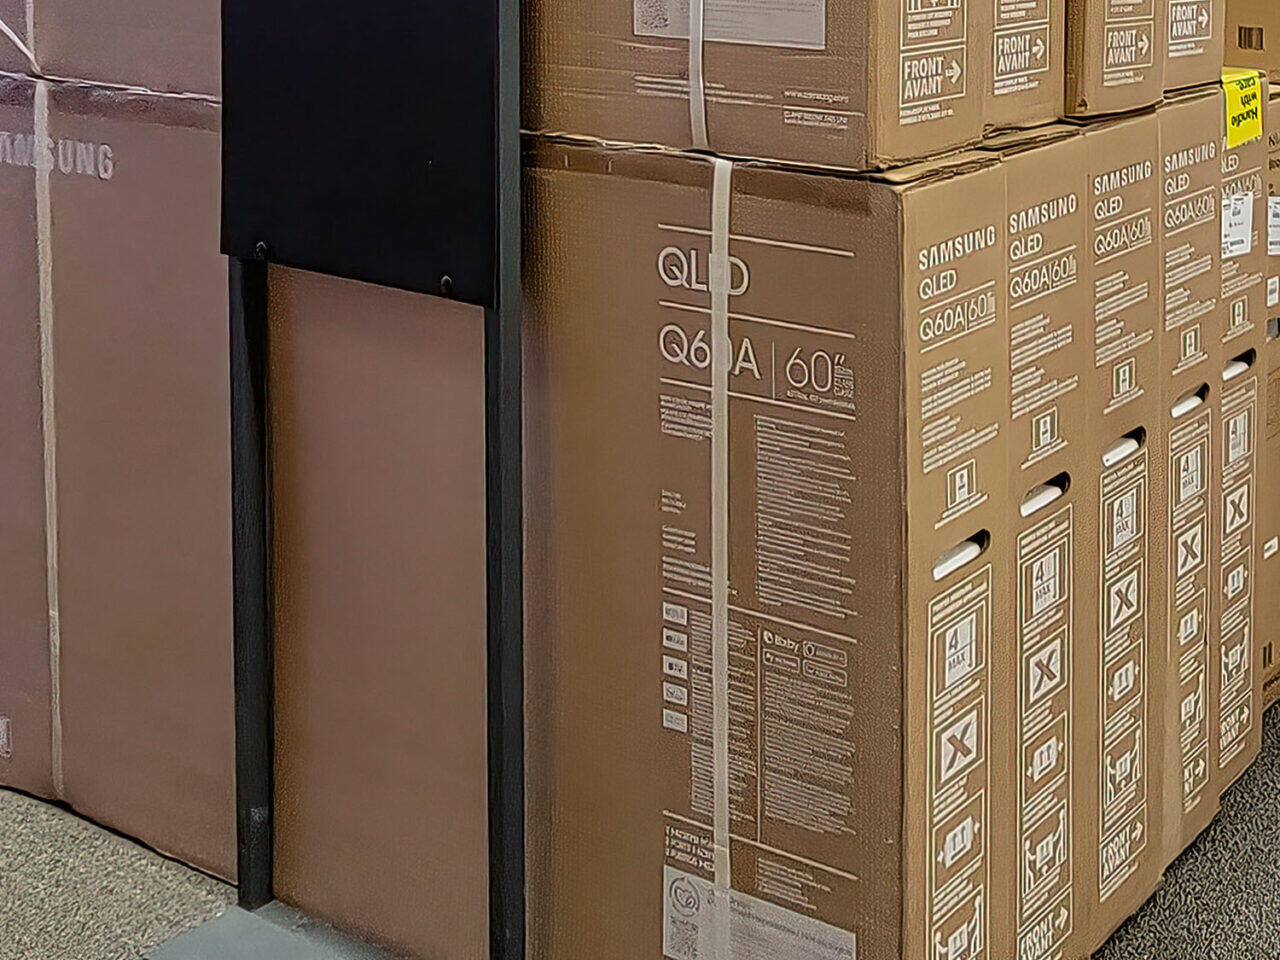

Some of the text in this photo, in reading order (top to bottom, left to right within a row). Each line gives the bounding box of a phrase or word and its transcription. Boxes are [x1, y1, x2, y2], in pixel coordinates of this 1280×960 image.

[1172, 4, 1197, 22] FRONT
[1107, 29, 1137, 49] FRONT
[1172, 19, 1197, 38] AVANT
[998, 34, 1031, 56] FRONT
[1107, 46, 1137, 65] AVANT
[904, 57, 945, 82] FRONT
[998, 52, 1030, 74] AVANT
[904, 76, 943, 100] AVANT
[1164, 142, 1215, 173] SAMSUNG
[1094, 160, 1152, 196] SAMSUNG
[1165, 173, 1190, 195] QLED
[1009, 194, 1077, 234] SAMSUNG
[1094, 196, 1123, 220] QLED
[1164, 201, 1195, 228] Q60A
[918, 225, 996, 270] SAMSUNG
[1010, 233, 1043, 261] QLED
[1094, 224, 1129, 255] Q60A
[658, 246, 749, 296] QLD
[1009, 266, 1049, 298] Q60A
[919, 269, 957, 300] QLED
[920, 304, 965, 341] Q60A
[1035, 561, 1044, 583] 4
[949, 627, 959, 651] 4
